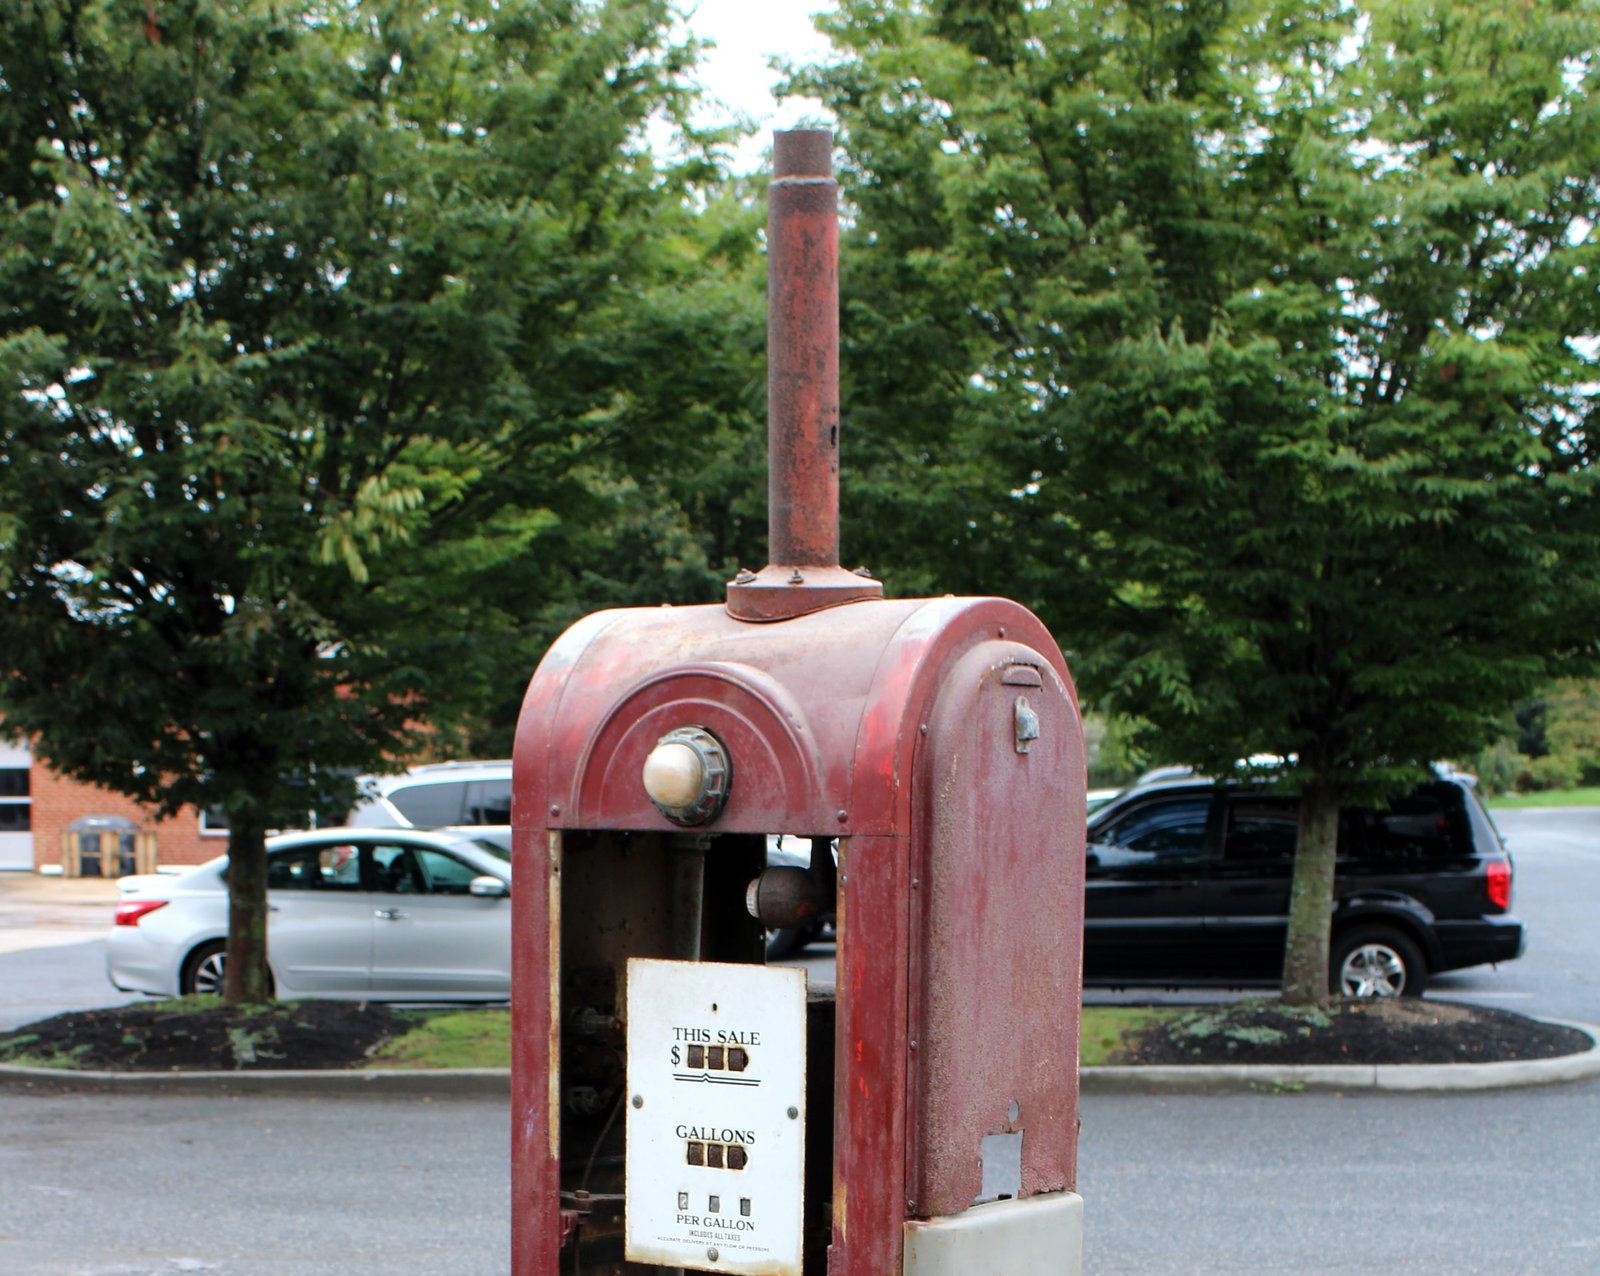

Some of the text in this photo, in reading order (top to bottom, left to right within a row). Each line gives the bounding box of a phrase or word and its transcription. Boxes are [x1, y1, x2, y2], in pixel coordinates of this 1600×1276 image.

[672, 1027, 761, 1046] THIS SALE
[670, 1044, 681, 1068] $
[676, 1124, 756, 1145] GALLONS
[676, 1214, 755, 1231] PER GALLON
[688, 1229, 741, 1242] INCLUDES ALL TAXES
